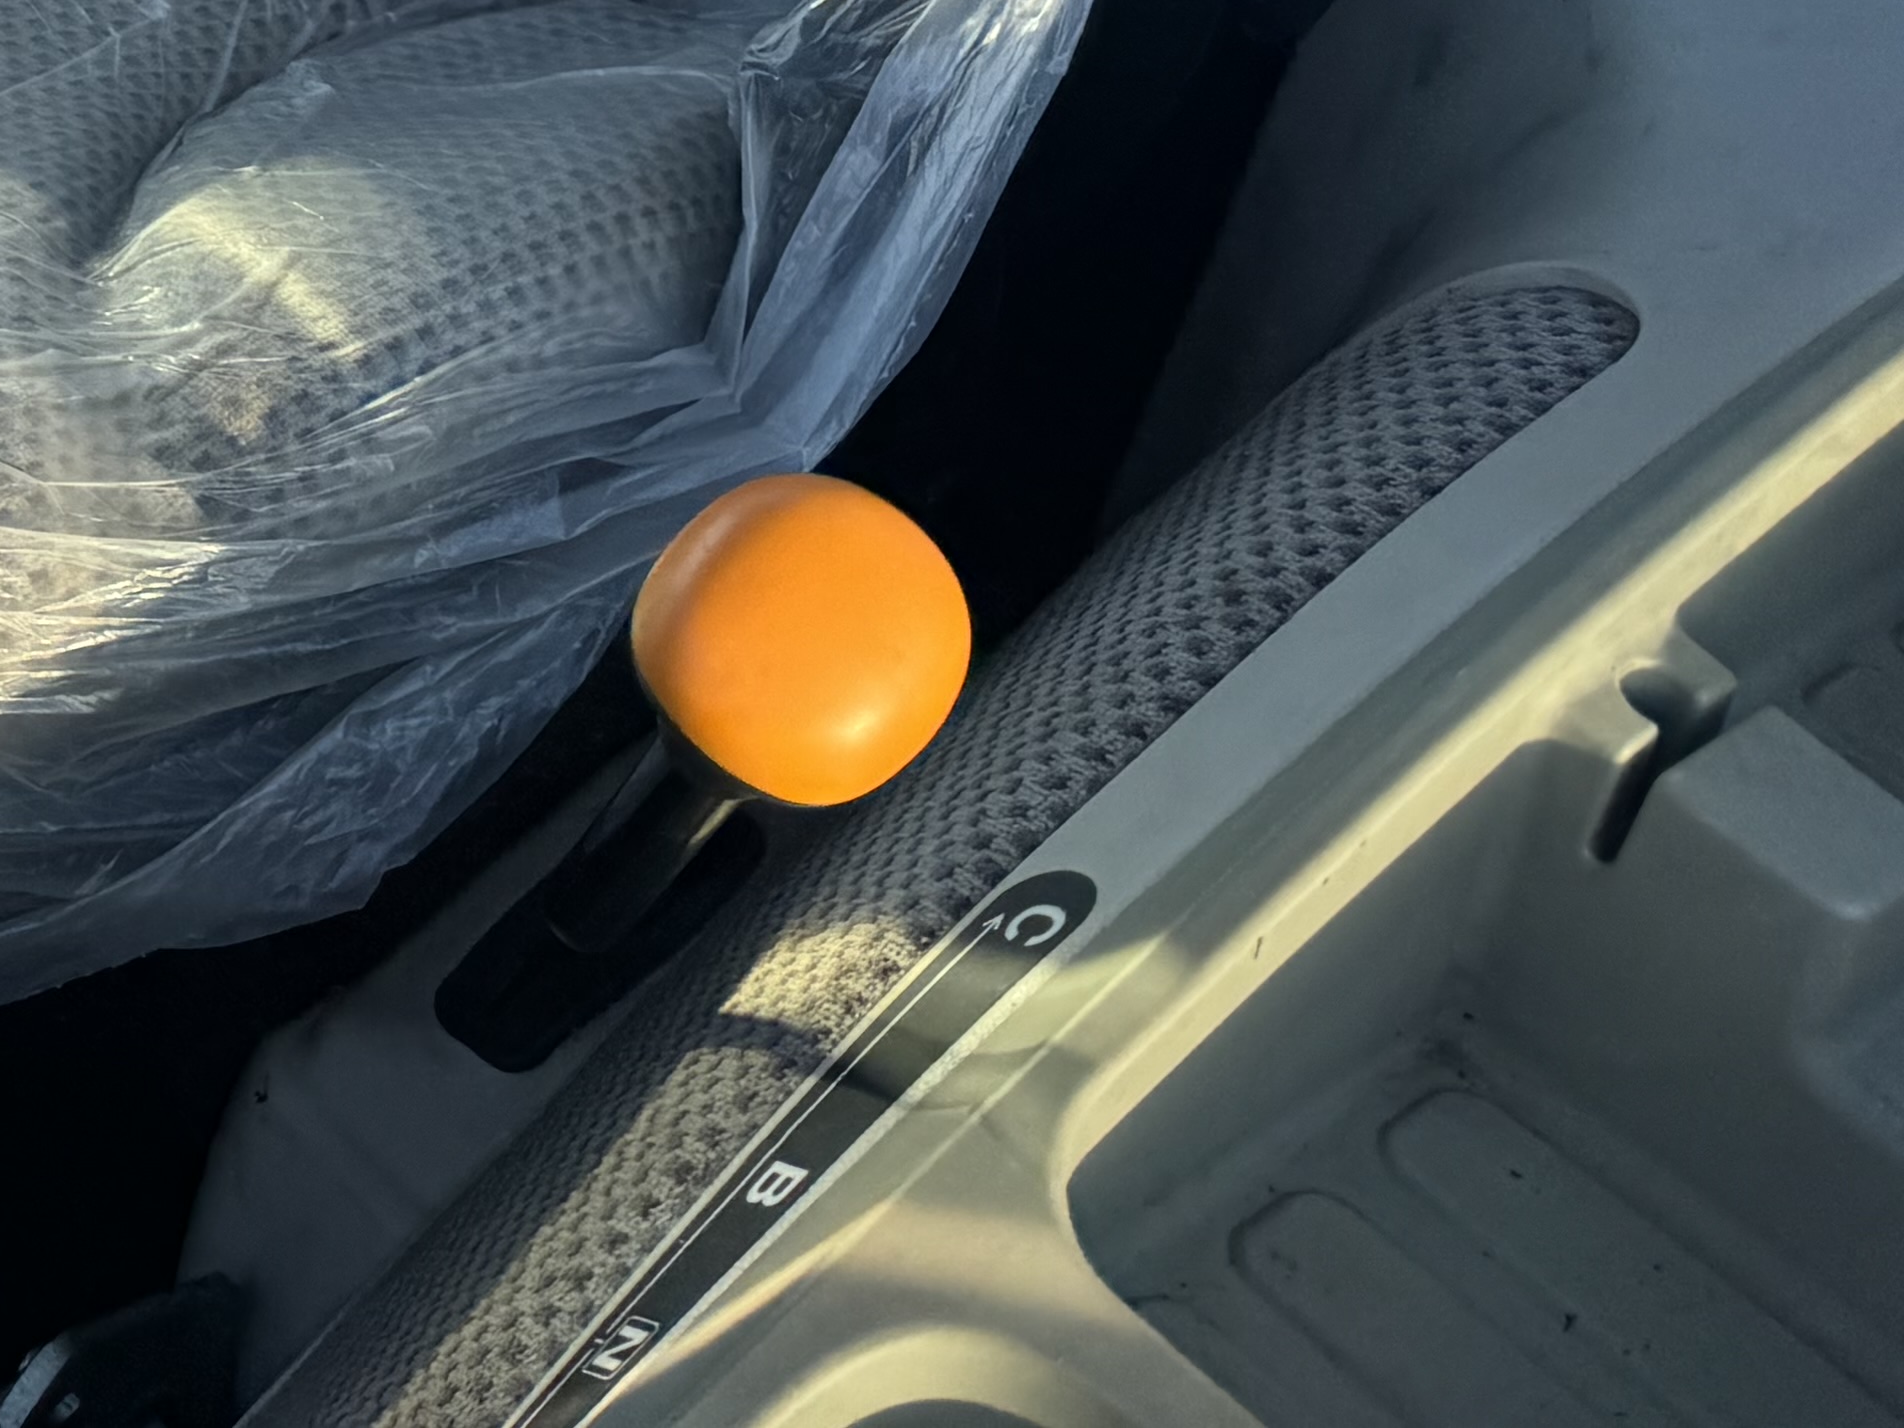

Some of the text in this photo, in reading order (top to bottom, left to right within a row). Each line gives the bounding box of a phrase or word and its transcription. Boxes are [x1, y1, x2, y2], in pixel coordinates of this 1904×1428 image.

[1003, 903, 1067, 947] C
[745, 1159, 810, 1207] B
[591, 1324, 651, 1372] N
